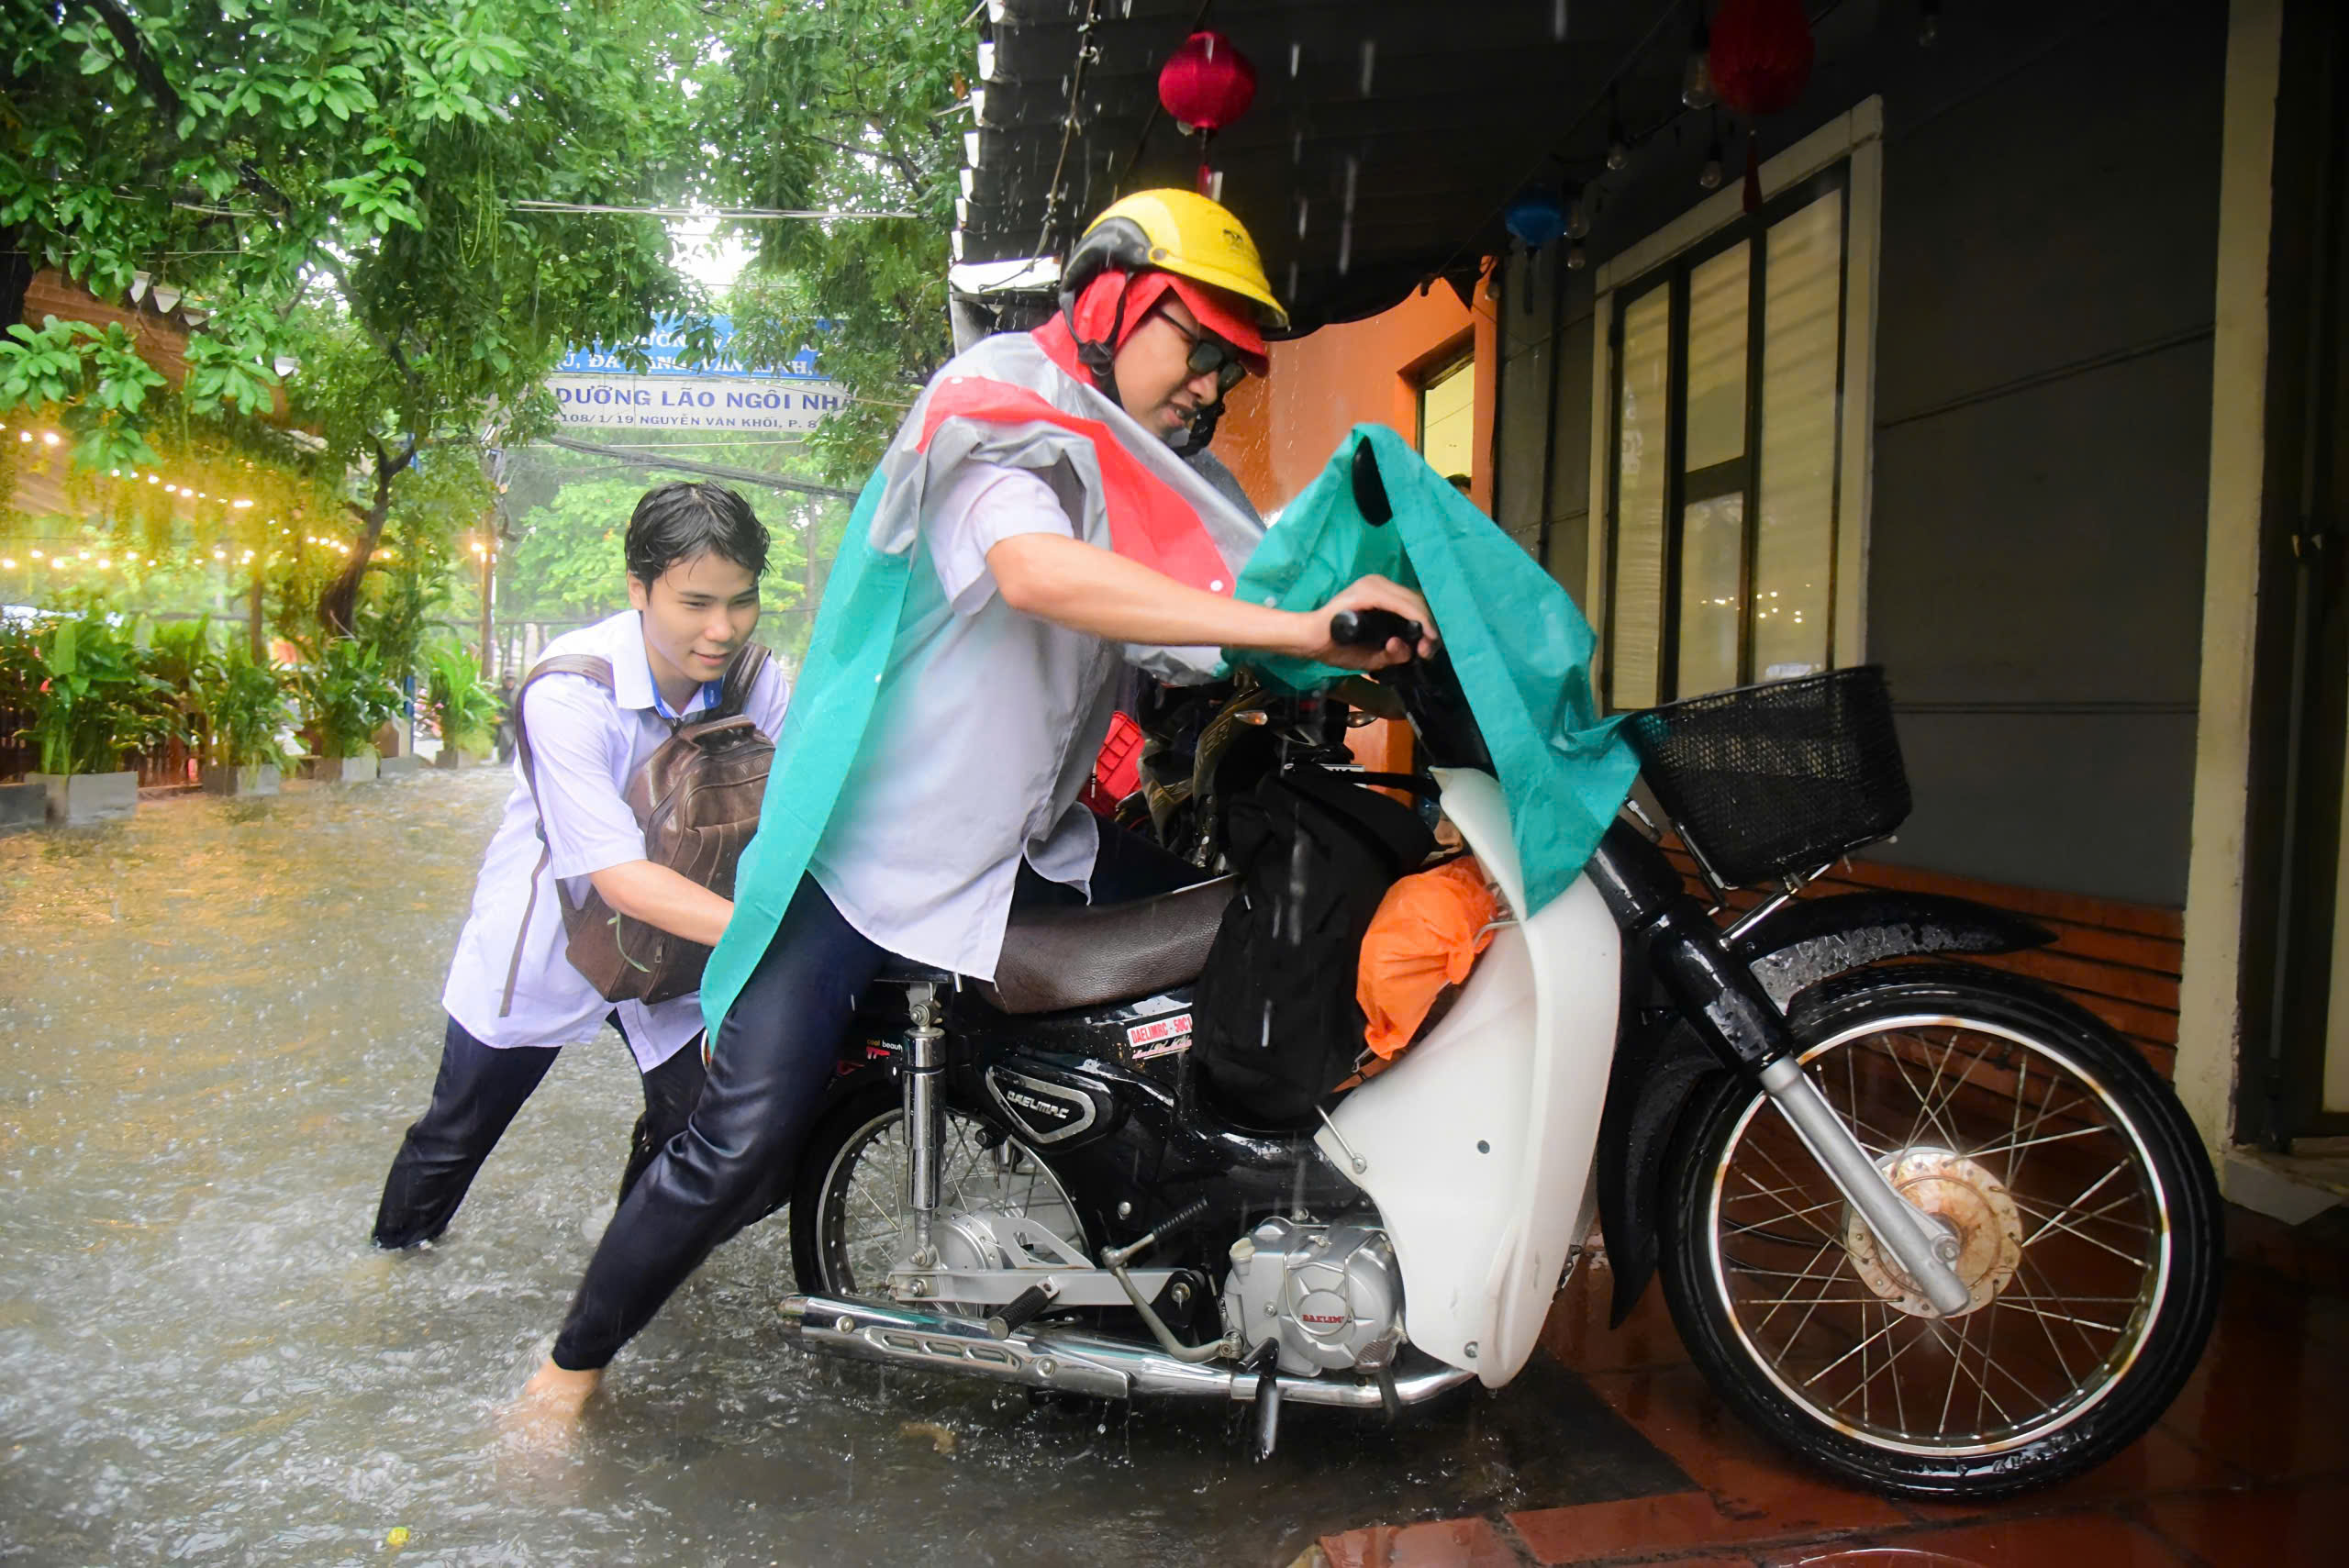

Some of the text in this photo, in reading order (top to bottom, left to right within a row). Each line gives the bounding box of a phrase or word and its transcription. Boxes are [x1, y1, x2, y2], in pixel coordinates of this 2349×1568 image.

[662, 387, 715, 407] LÃO
[727, 389, 791, 410] NGÔI
[802, 395, 853, 411] NH
